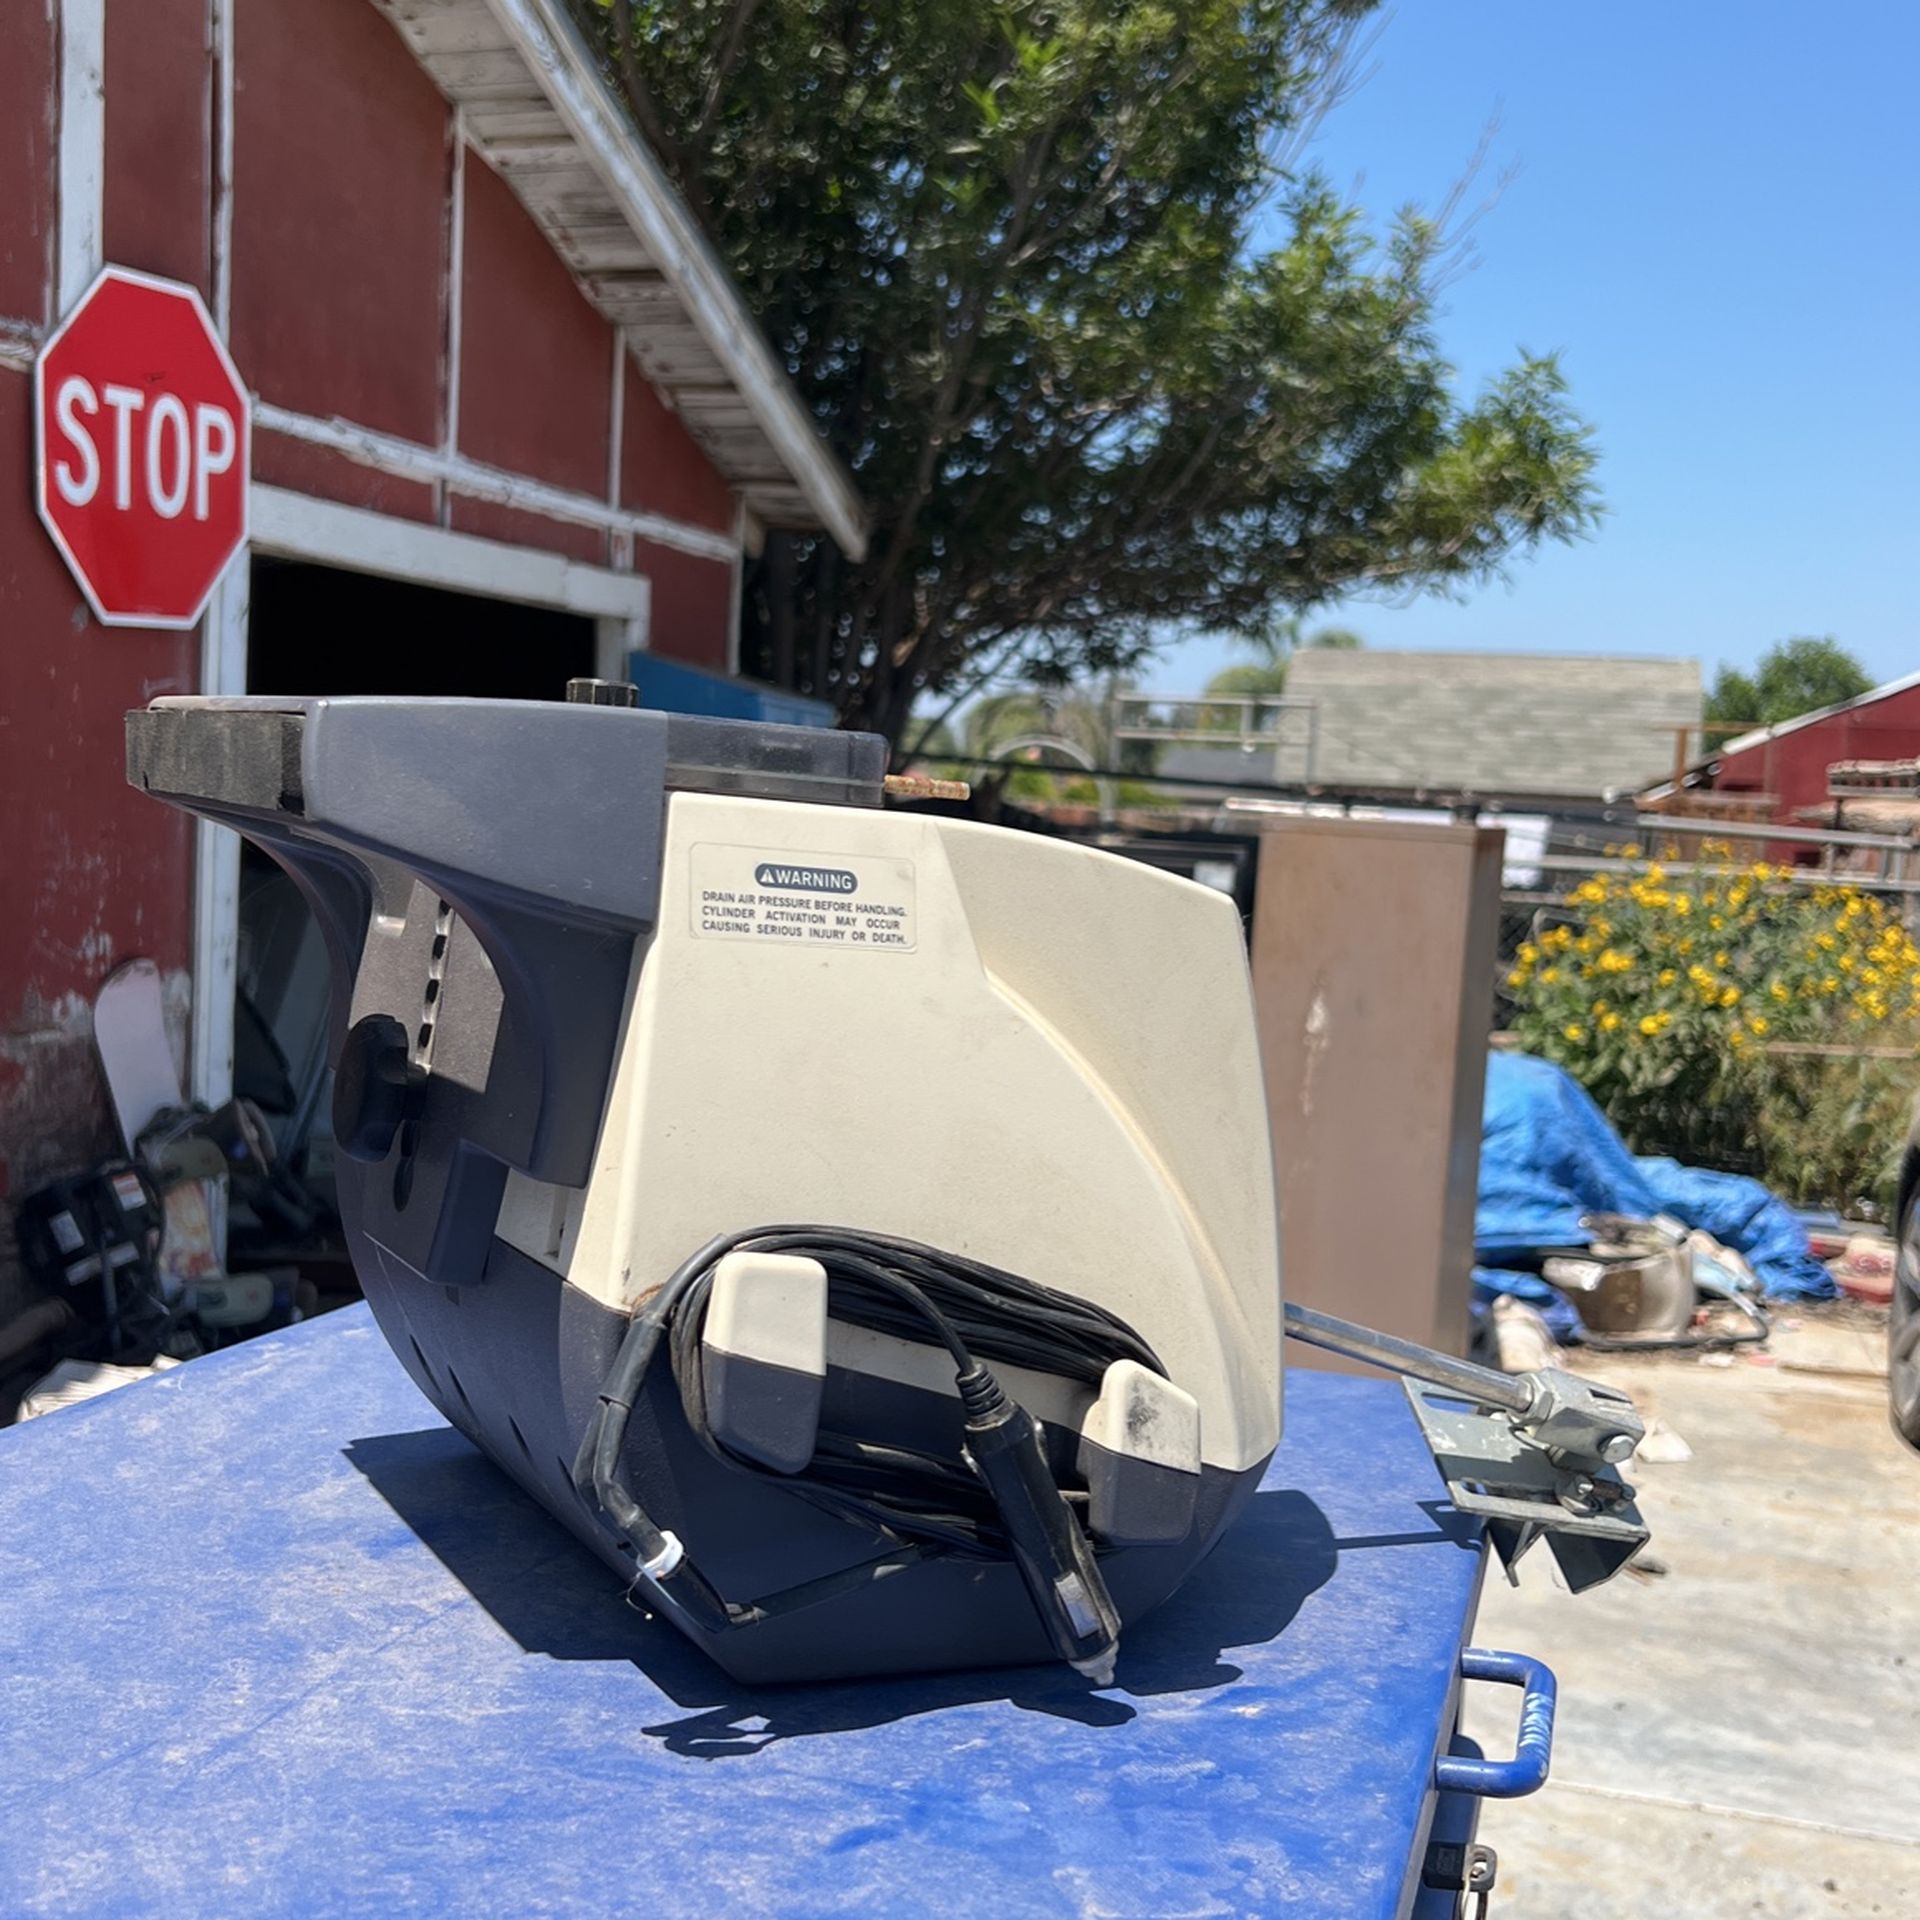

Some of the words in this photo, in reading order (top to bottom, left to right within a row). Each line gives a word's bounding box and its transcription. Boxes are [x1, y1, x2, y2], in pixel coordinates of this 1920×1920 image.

[55, 375, 236, 521] STOP
[775, 869, 853, 889] WARNING
[702, 891, 735, 903] DRAIN
[738, 894, 756, 904] AIR
[758, 895, 811, 910] PRESSURE
[814, 899, 853, 913] BEFORE
[856, 903, 907, 917] HANDLING.
[702, 905, 755, 919] CYLINDER
[765, 910, 826, 924] ACTIVATION
[836, 916, 857, 927] MAY
[866, 918, 900, 930] OCCUR
[702, 919, 750, 933] CAUSING
[757, 923, 802, 937] SERIOUS
[809, 927, 845, 940] INJURY
[851, 930, 866, 942] OR
[872, 932, 906, 945] DEATH.
